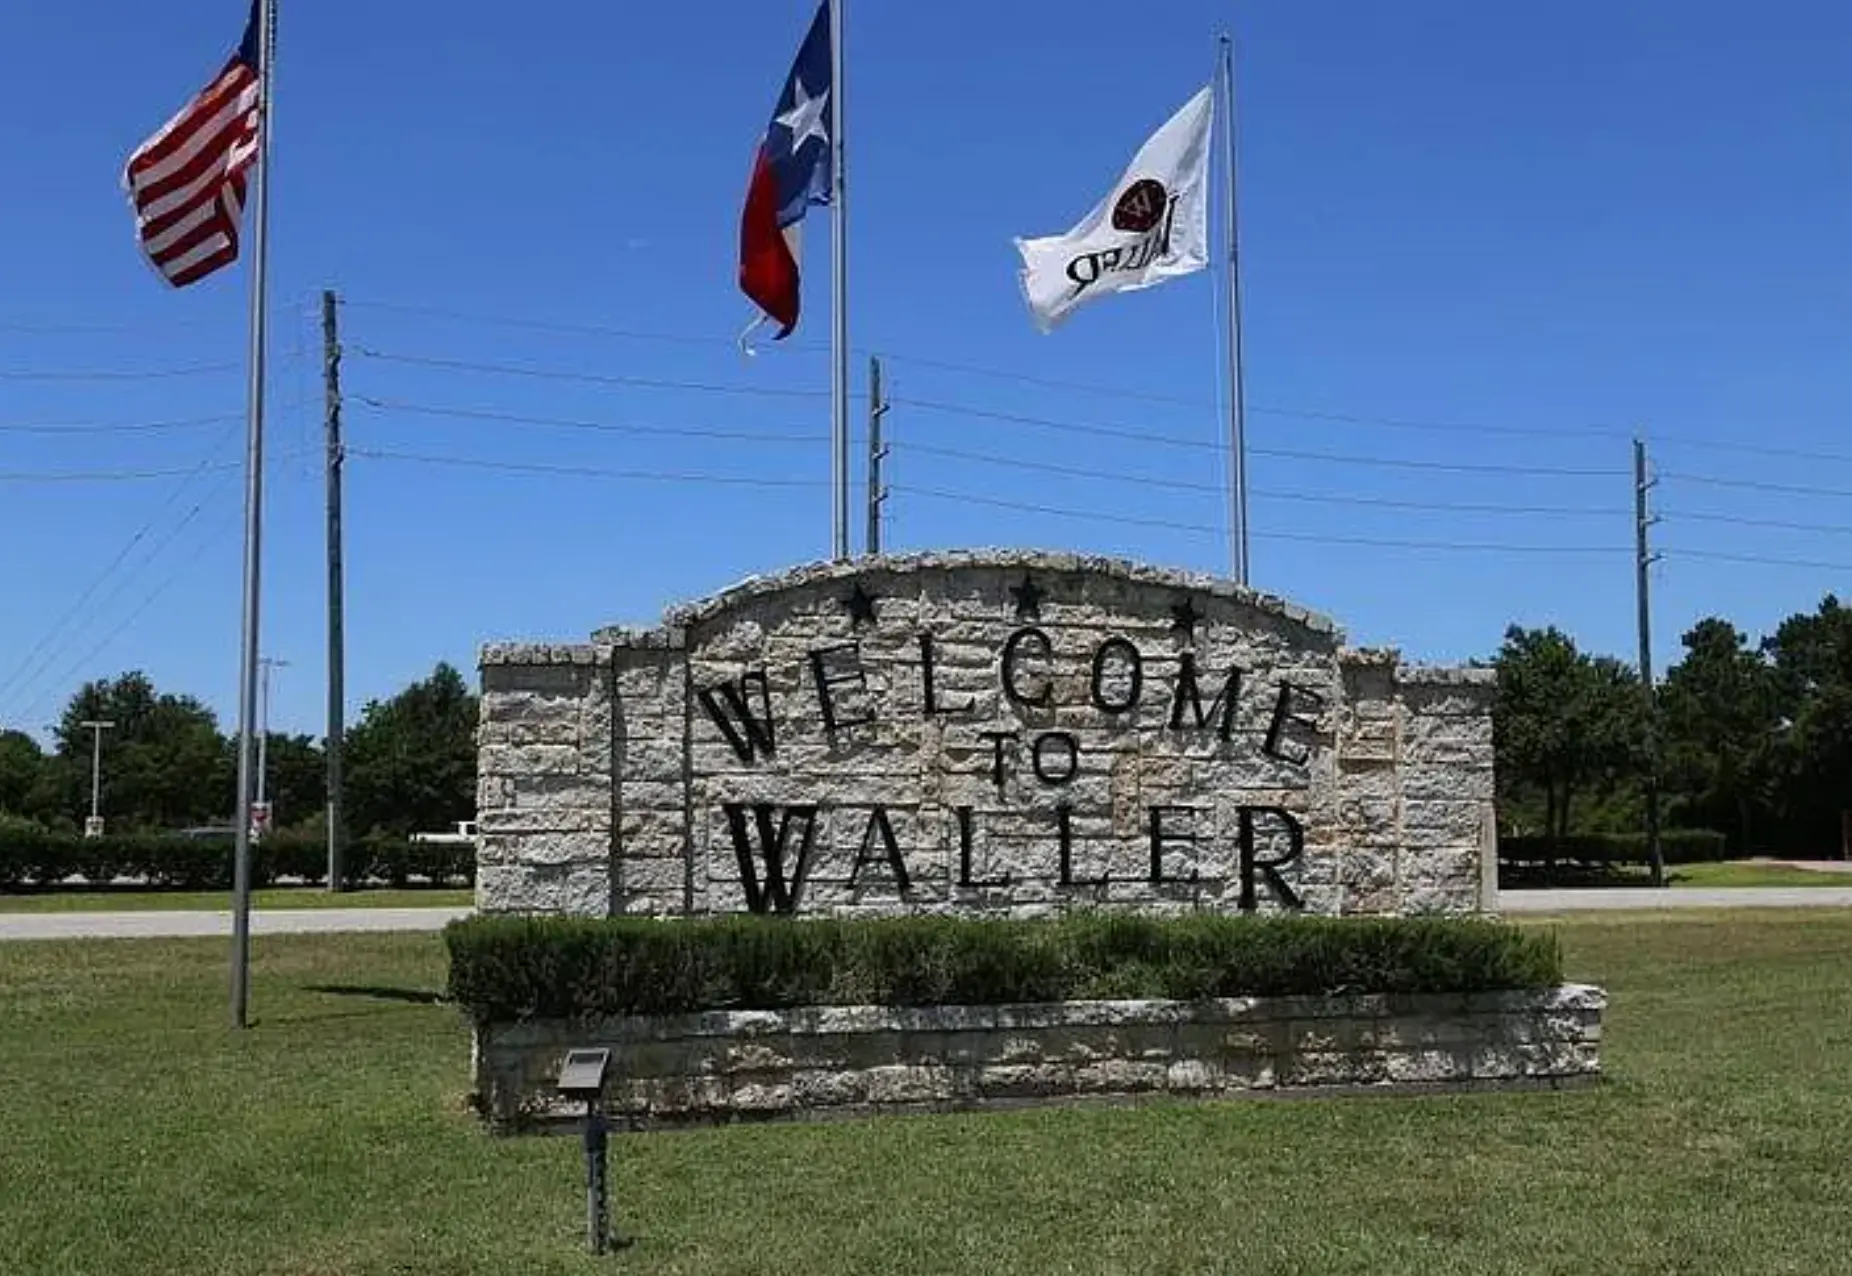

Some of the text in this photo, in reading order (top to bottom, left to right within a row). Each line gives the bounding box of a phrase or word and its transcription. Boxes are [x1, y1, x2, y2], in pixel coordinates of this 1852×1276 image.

[700, 626, 1323, 767] WELCOME
[979, 731, 1078, 786] TO
[723, 804, 1301, 914] WALLER
